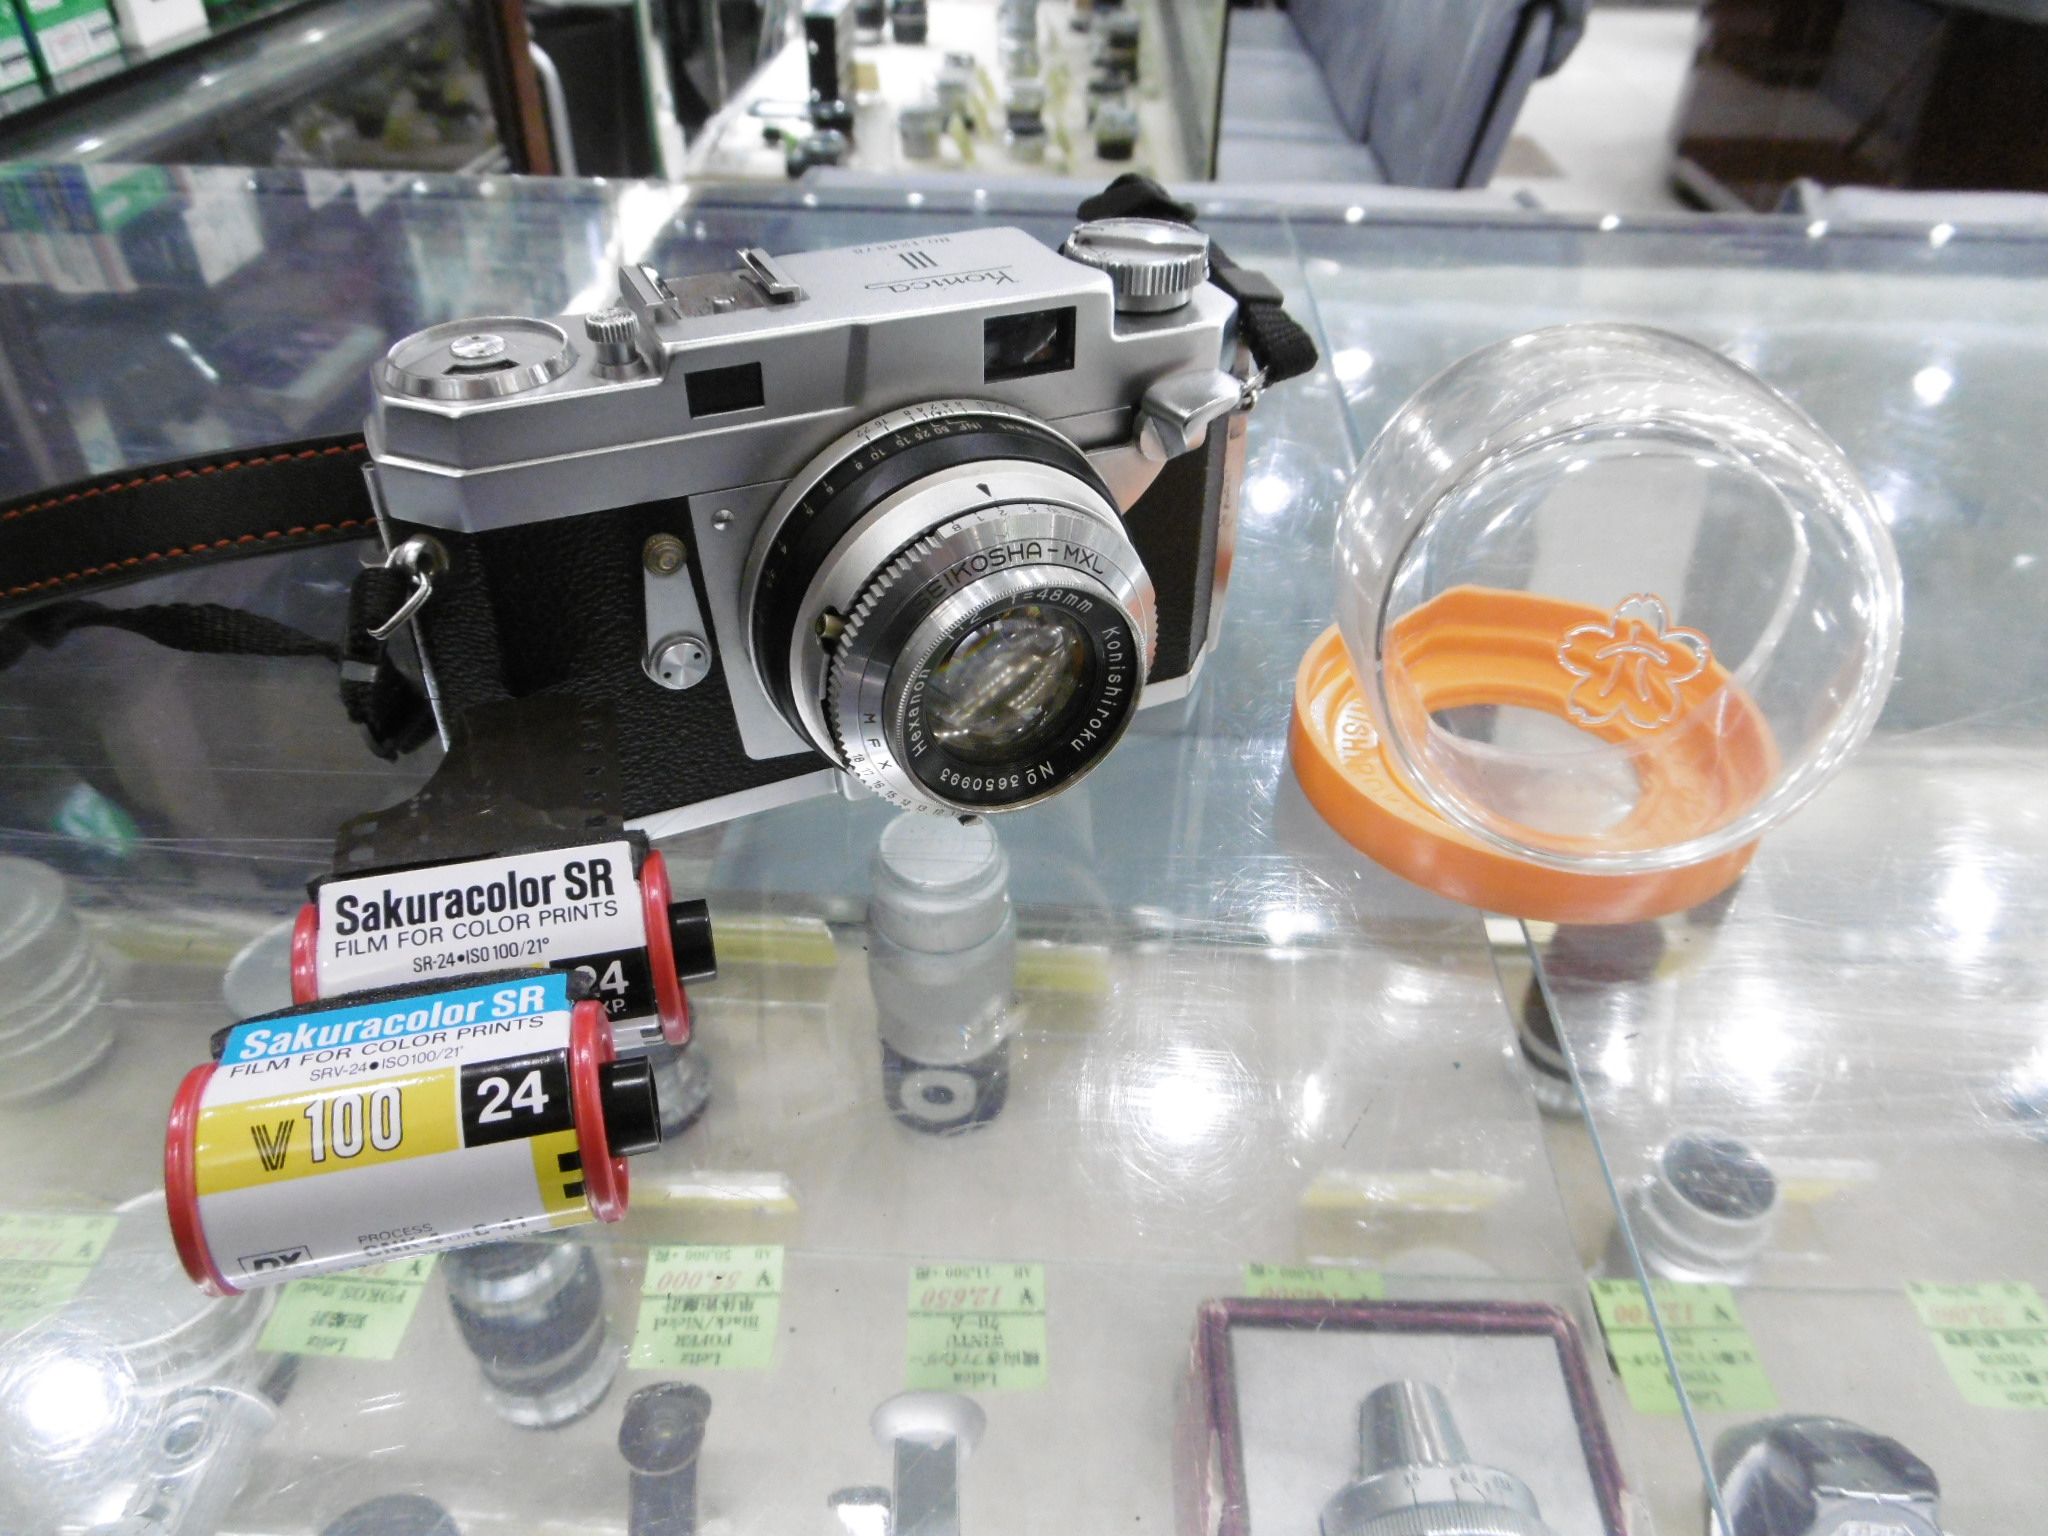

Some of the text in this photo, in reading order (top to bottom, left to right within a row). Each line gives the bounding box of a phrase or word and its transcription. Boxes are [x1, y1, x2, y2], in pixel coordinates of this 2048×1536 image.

[864, 267, 1019, 294] Konica
[875, 418, 889, 428] 16
[915, 429, 931, 441] 25
[959, 421, 983, 432] INF
[870, 448, 887, 461] 10
[896, 436, 912, 448] 15
[855, 461, 865, 472] 8
[825, 486, 835, 496] 6
[952, 523, 963, 532] B
[1070, 626, 1124, 752] Konishiroku
[910, 668, 931, 758] Hexanon
[863, 713, 892, 770] M F X
[852, 753, 866, 763] 18
[873, 780, 886, 789] 16
[884, 790, 899, 799] 15
[938, 766, 1021, 792] 3650993
[335, 857, 615, 936] Sakuracolor SR
[335, 900, 619, 957] FILM FOR COLOR PRINTS
[239, 985, 546, 1061] Sakuracolor SR
[229, 1014, 545, 1079] FILM FOR COLOR PRINTS
[476, 1070, 549, 1124] 24
[358, 1222, 434, 1245] PROCESS
